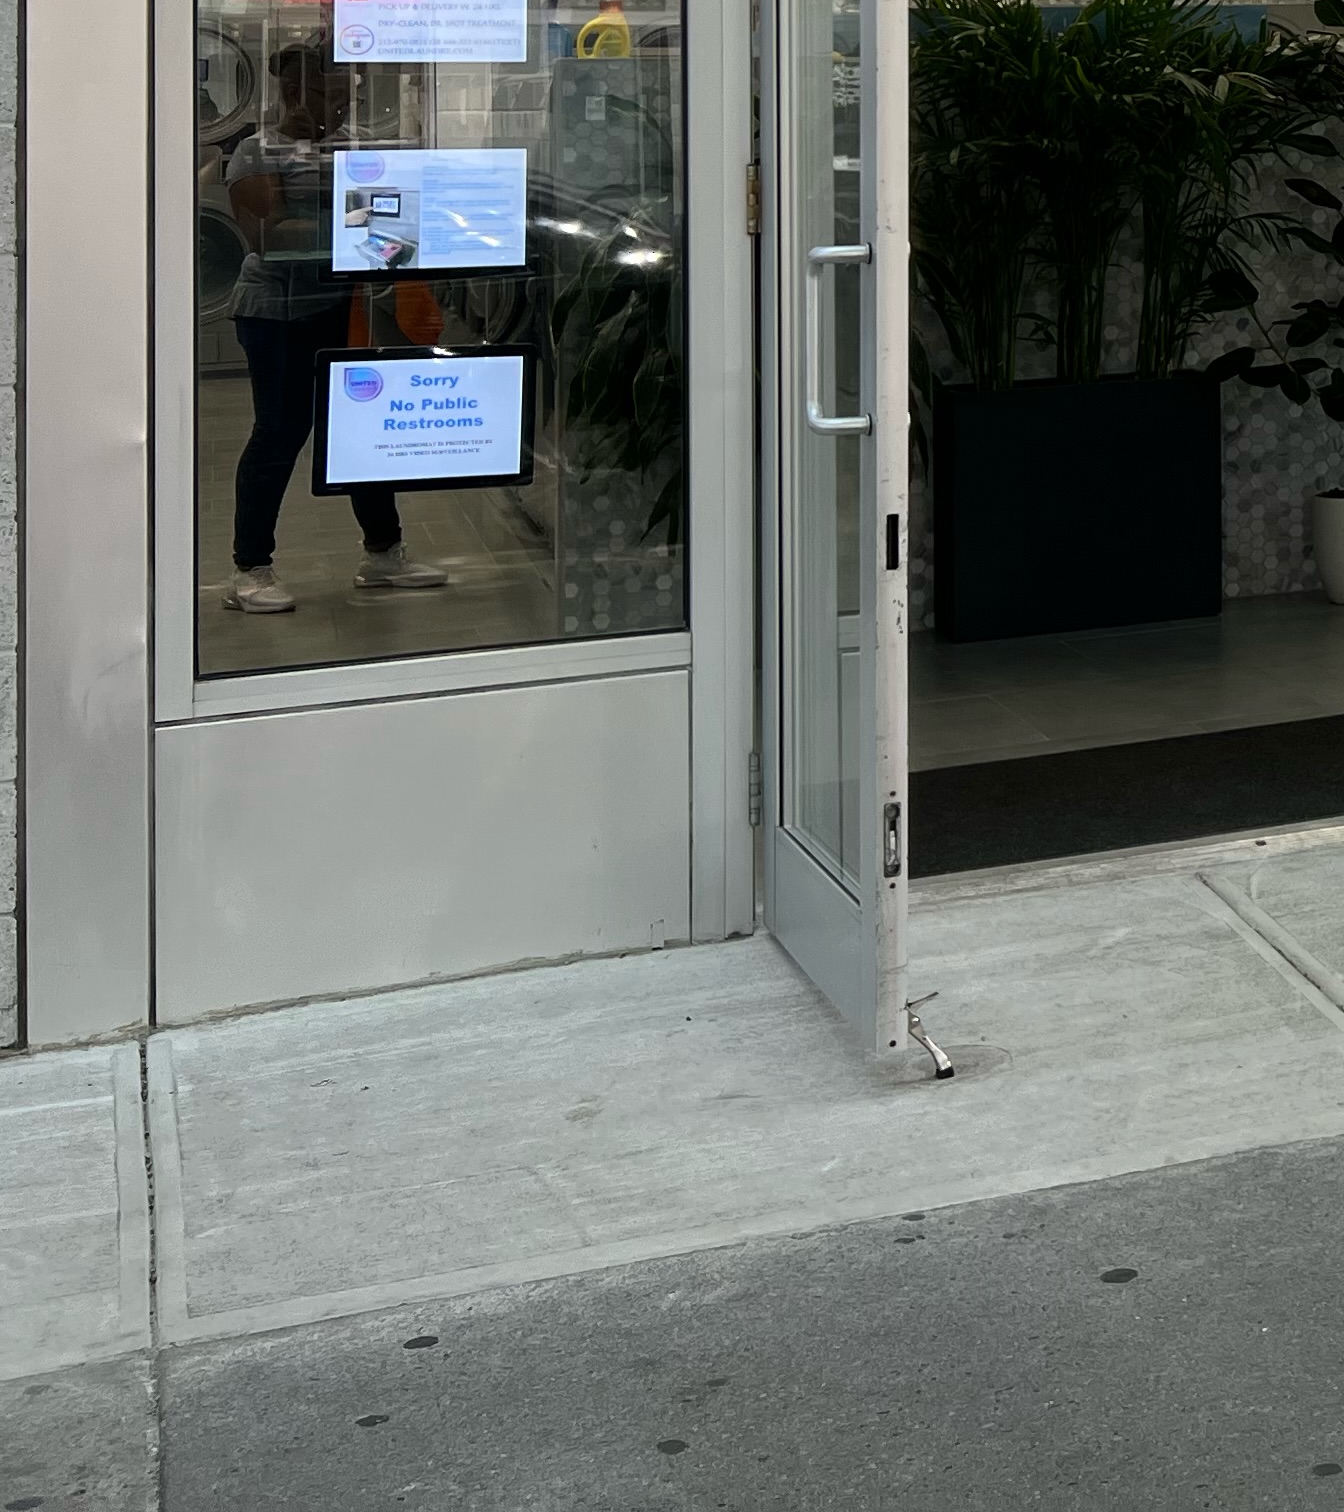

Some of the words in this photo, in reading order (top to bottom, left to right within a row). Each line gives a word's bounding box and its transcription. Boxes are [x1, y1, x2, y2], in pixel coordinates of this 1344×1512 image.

[410, 374, 460, 389] Sorry
[389, 399, 415, 412] No
[421, 397, 479, 411] Public
[383, 416, 484, 431] Restrooms
